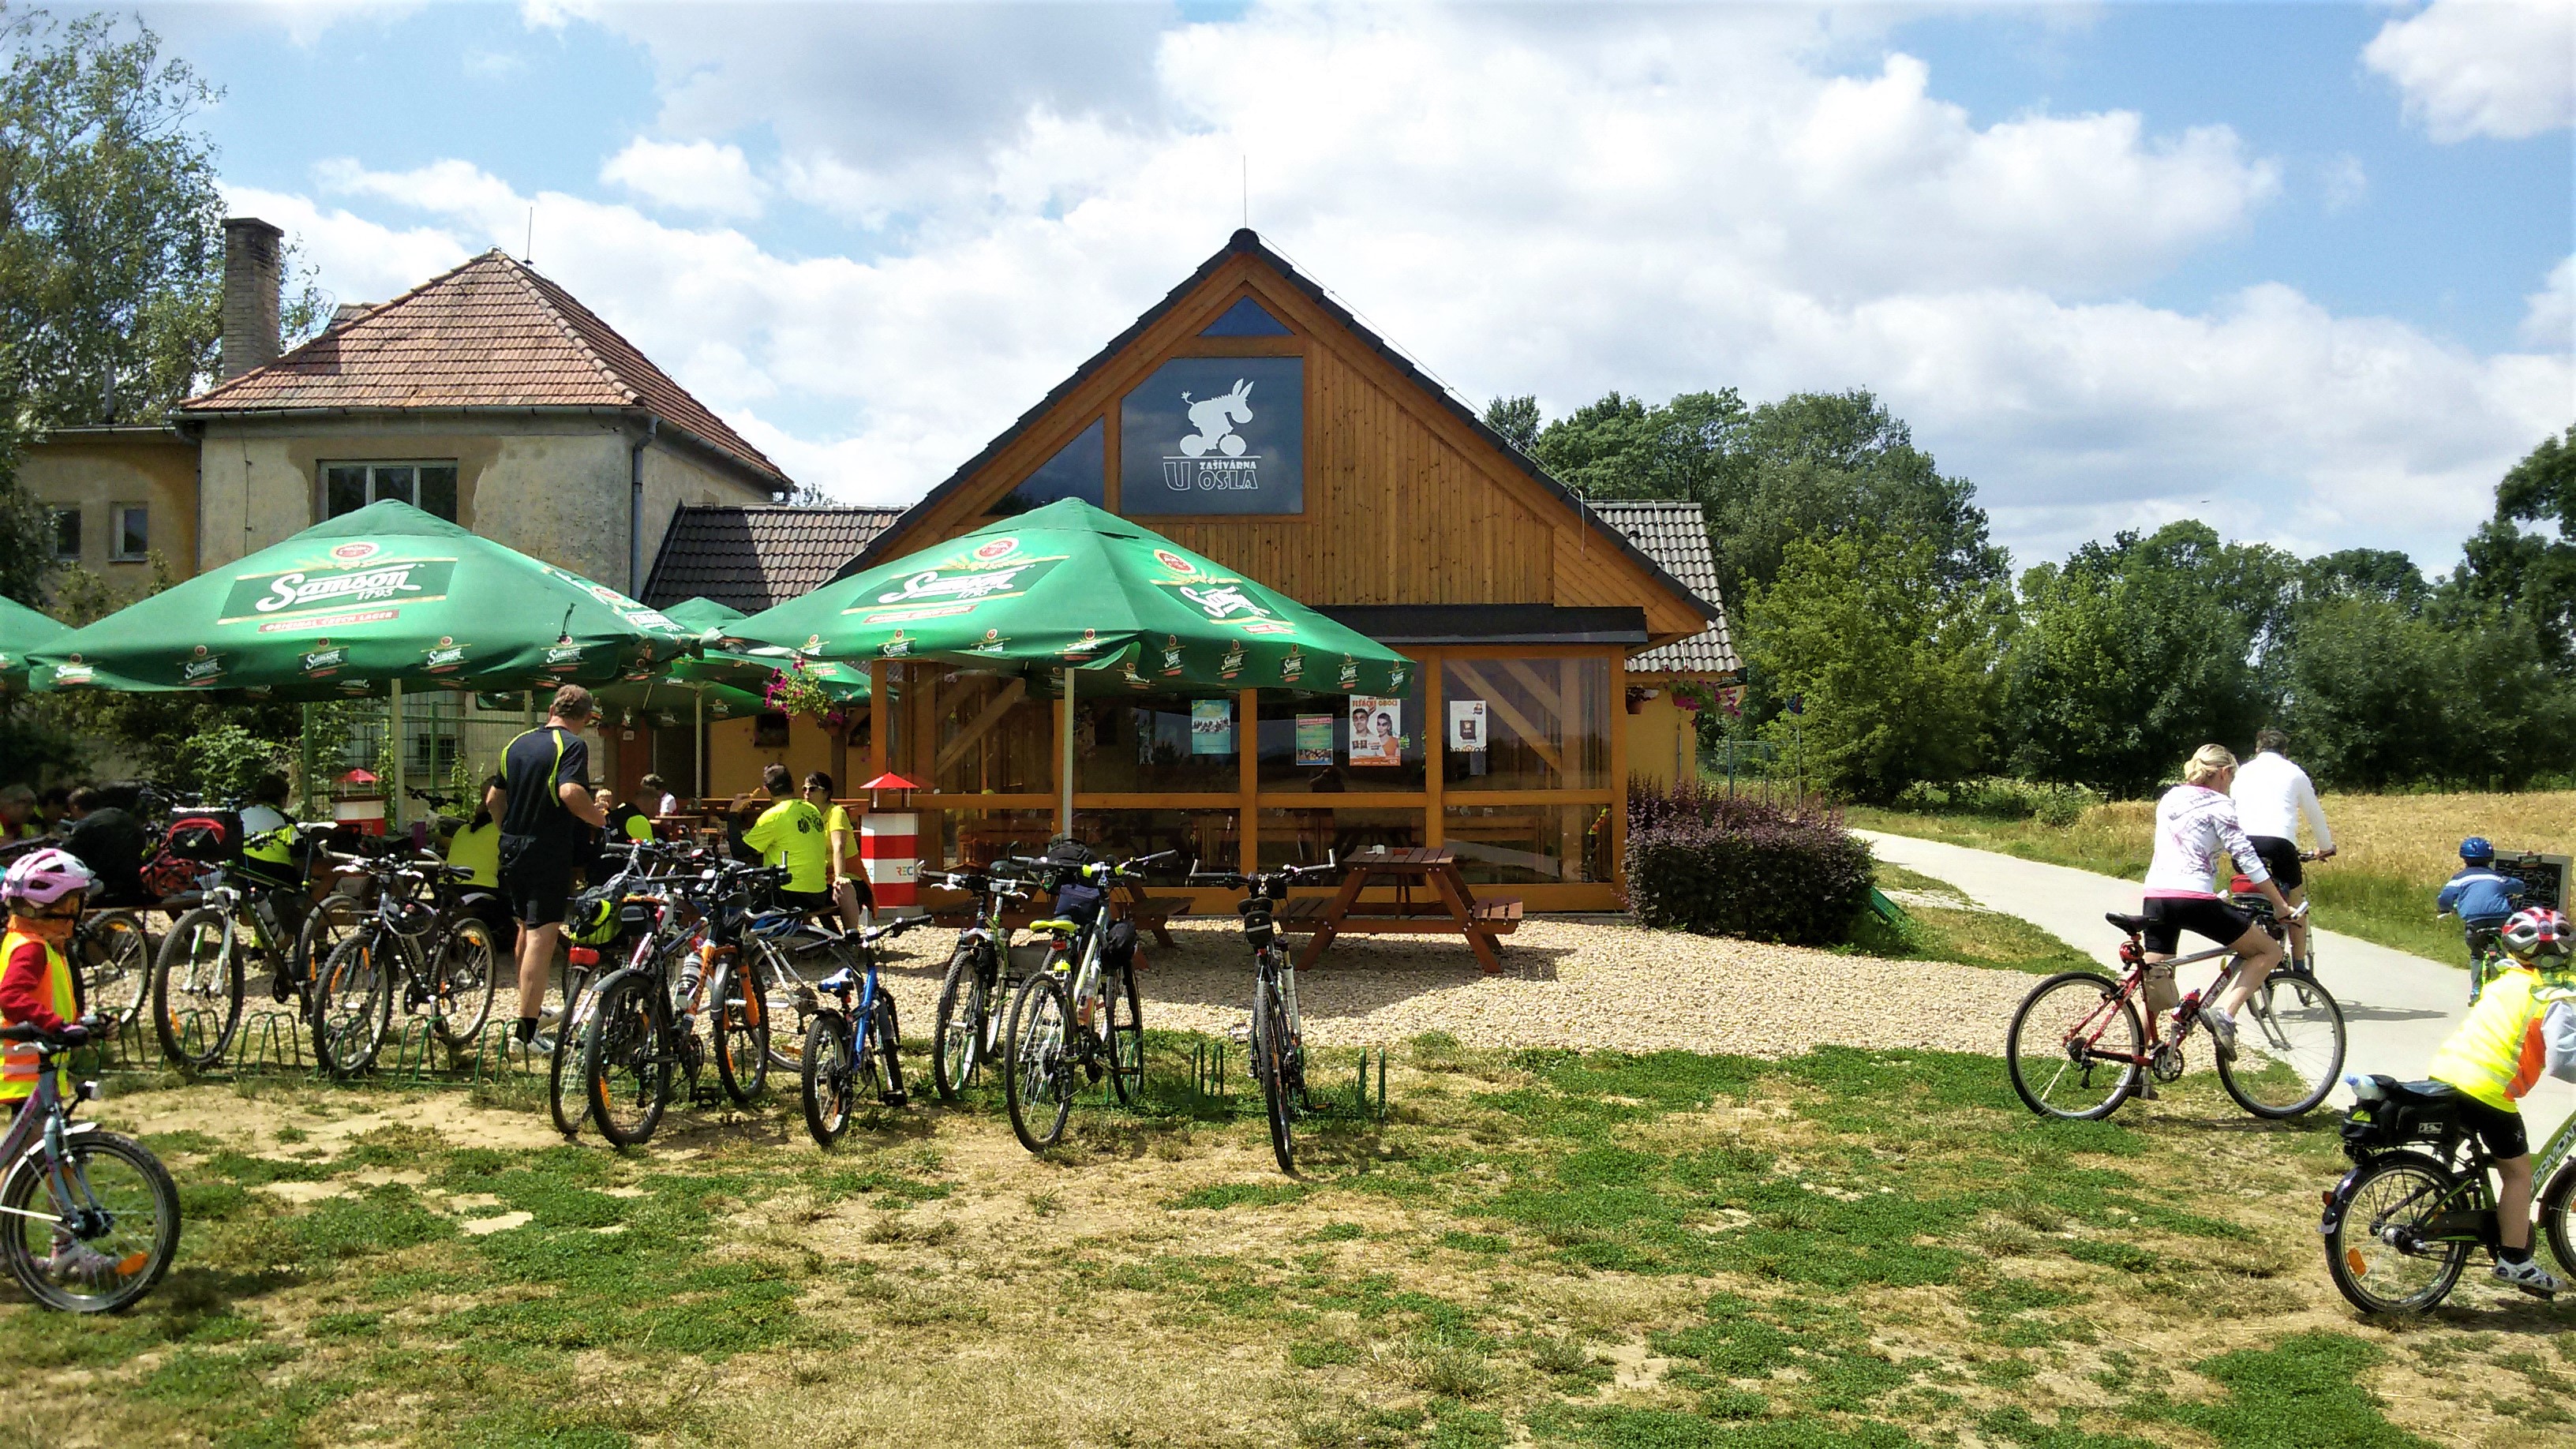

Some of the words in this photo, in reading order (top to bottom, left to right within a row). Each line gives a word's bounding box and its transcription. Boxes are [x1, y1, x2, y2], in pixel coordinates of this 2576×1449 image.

[1199, 459, 1257, 470] ZAŠÍVÁRNA
[1163, 461, 1191, 491] U
[1197, 470, 1259, 490] OSLA
[255, 568, 423, 612] Samson
[356, 587, 395, 601] 1795
